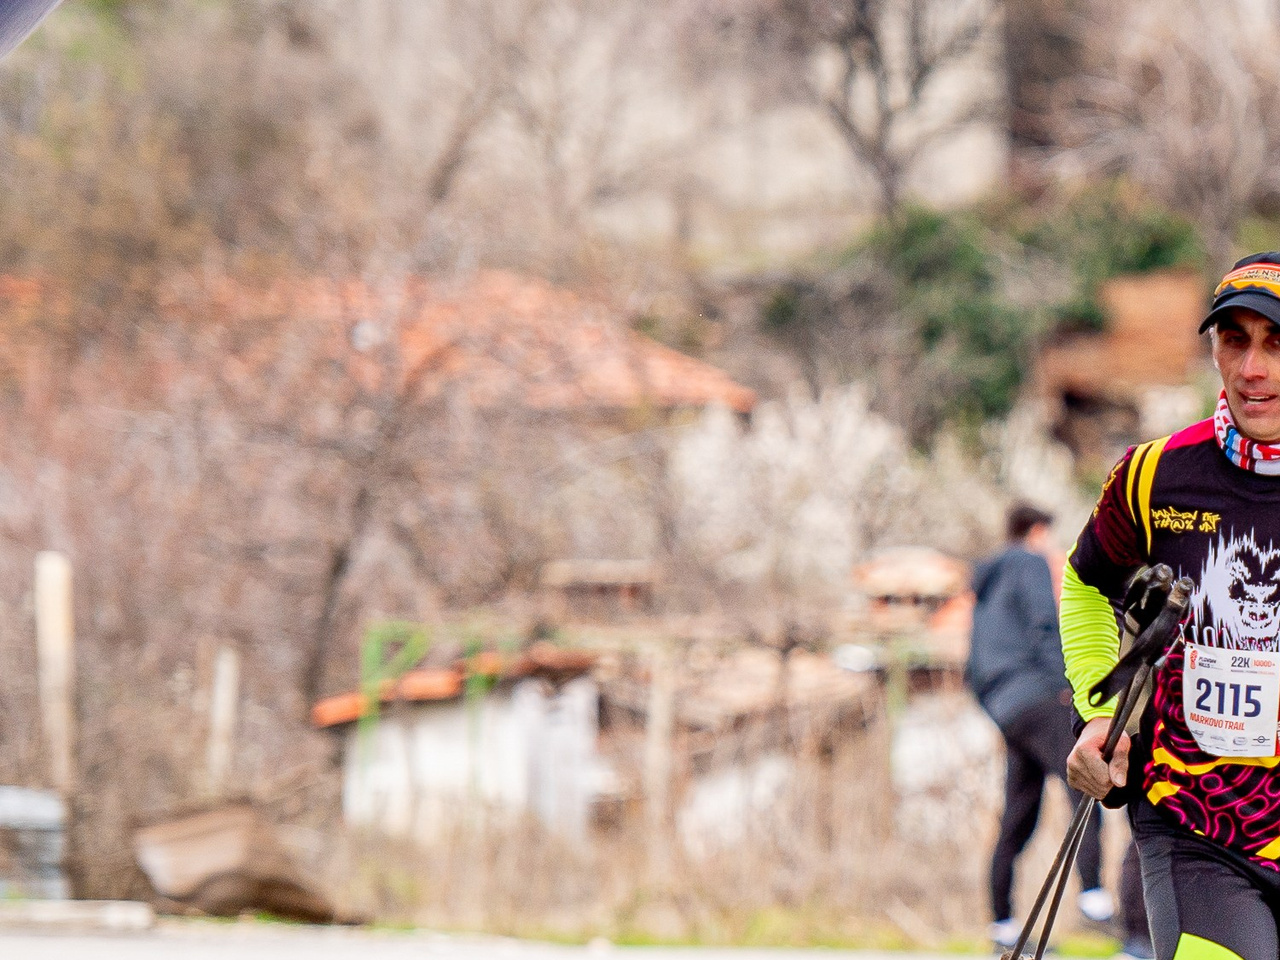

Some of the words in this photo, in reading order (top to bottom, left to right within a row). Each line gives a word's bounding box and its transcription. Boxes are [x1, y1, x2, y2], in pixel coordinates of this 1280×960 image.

[1231, 656, 1250, 668] 22K
[1195, 678, 1262, 718] 2115
[1189, 713, 1223, 729] MARKOVO
[1224, 720, 1245, 731] TRAIL
